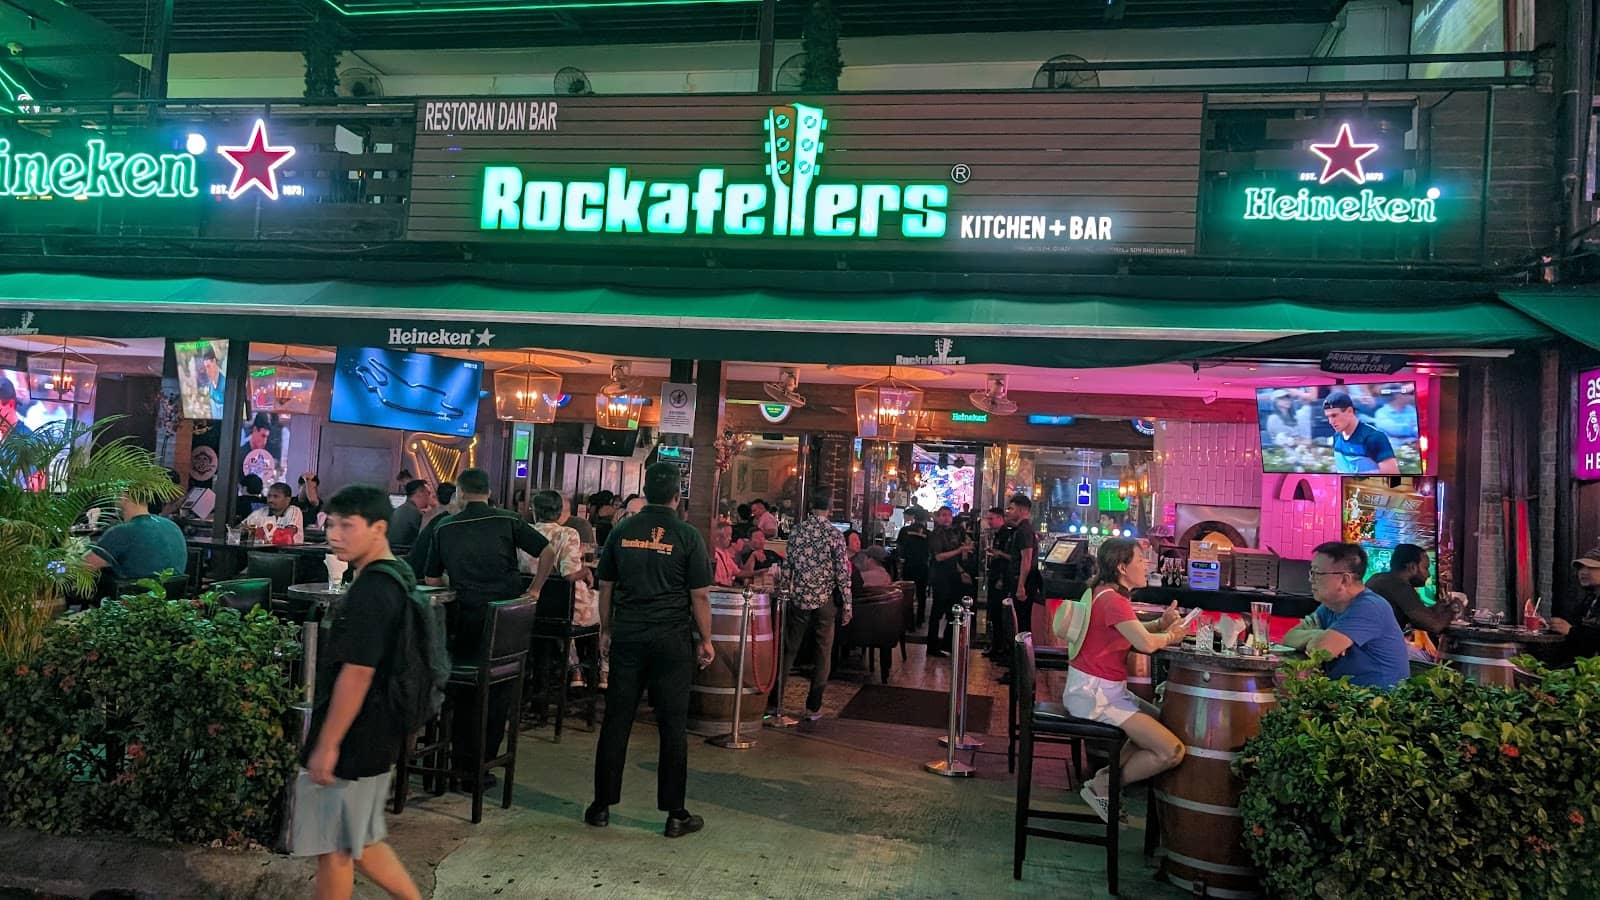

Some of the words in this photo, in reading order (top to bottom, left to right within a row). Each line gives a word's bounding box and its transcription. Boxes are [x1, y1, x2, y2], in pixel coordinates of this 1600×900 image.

[424, 102, 496, 131] RESTORAN
[497, 102, 527, 131] DAN
[529, 102, 558, 132] BAR
[479, 125, 949, 238] Rockafellers
[1243, 187, 1437, 223] Heineken
[960, 215, 1046, 240] KITCHEN
[1069, 216, 1113, 241] BAR
[388, 328, 472, 346] Heineken
[895, 347, 966, 365] Rockafellers
